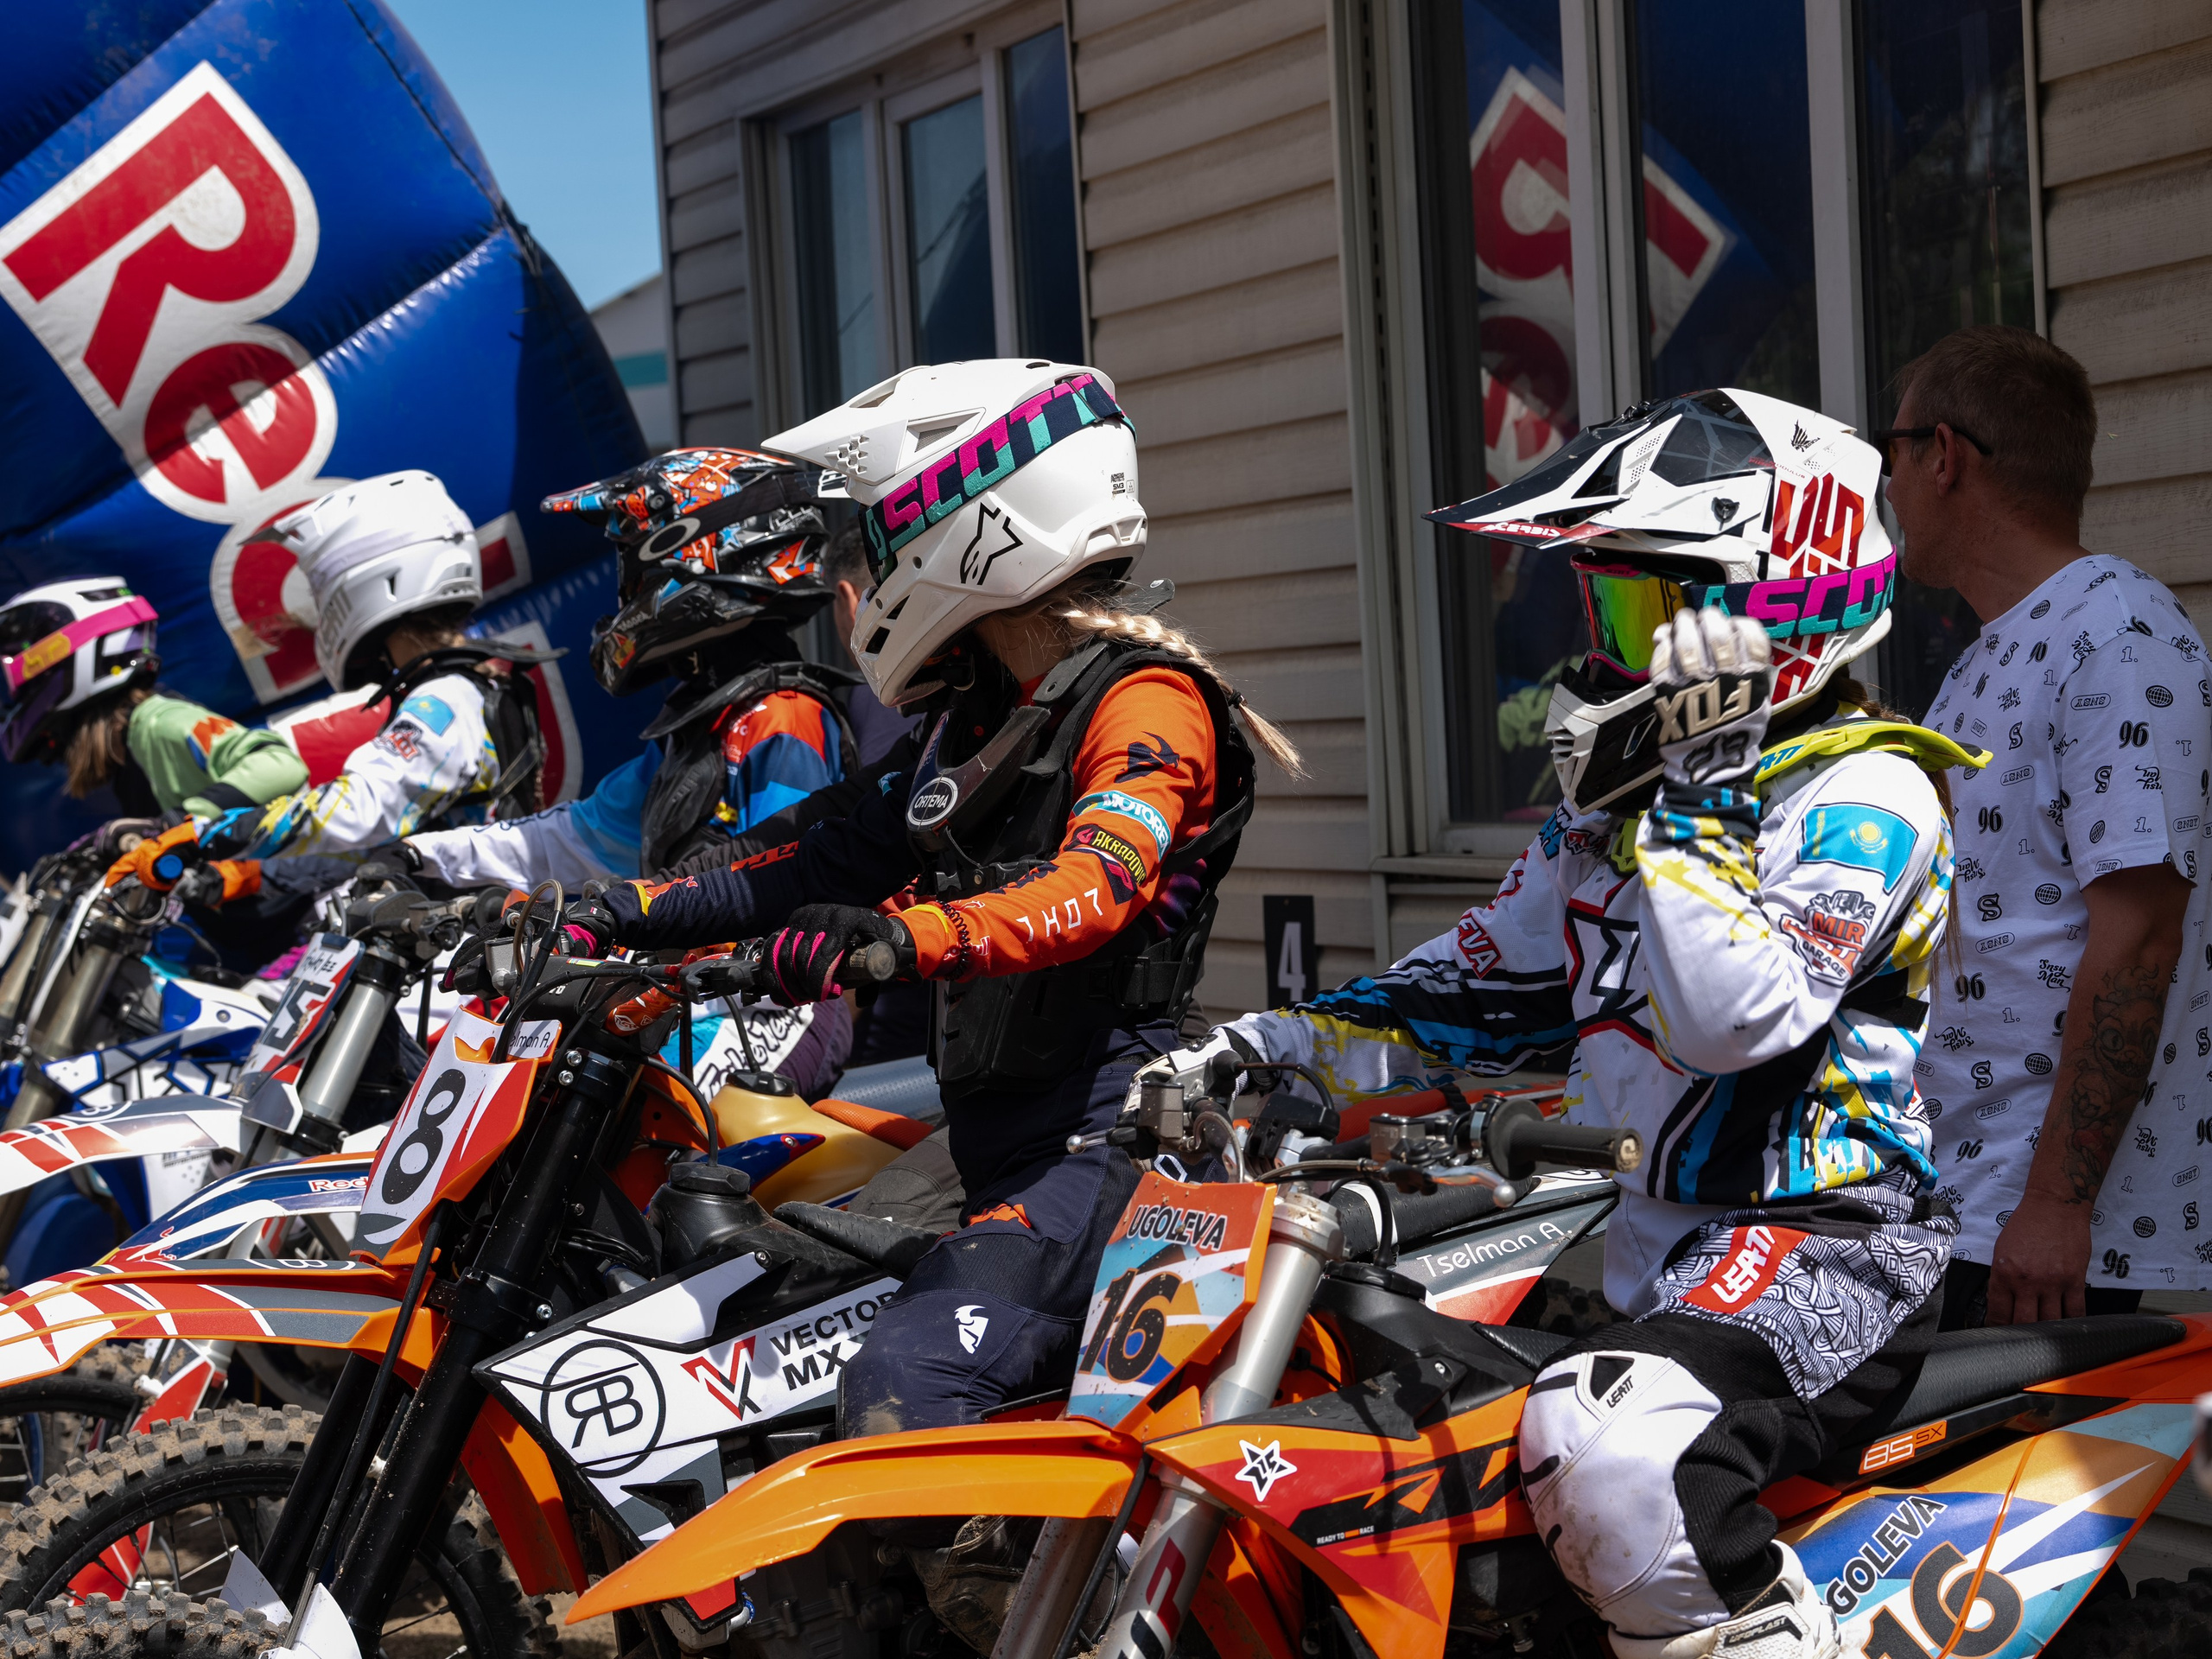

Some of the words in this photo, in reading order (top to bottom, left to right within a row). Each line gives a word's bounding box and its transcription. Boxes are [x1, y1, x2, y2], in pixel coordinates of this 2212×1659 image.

[2118, 720, 2150, 749] 96
[914, 793, 950, 809] ORTEMA
[1978, 804, 2004, 835] 96
[1977, 893, 2003, 922] S
[1814, 912, 1866, 944] MIR
[1278, 921, 1306, 1002] 4
[1802, 940, 1847, 977] GARAGE
[1954, 971, 1986, 1002] 96
[1970, 1059, 1993, 1090] S
[380, 1068, 467, 1205] 8
[1955, 1138, 1985, 1164] 96
[1127, 1205, 1228, 1251] UGOLEVA
[2183, 1201, 2200, 1231] S
[1416, 1234, 1538, 1278] Tselman
[2101, 1247, 2133, 1280] 96
[1077, 1267, 1184, 1383] 16
[782, 1342, 847, 1391] MX
[1606, 1375, 1635, 1409] LEATT
[1863, 1434, 1914, 1471] 85
[1915, 1424, 1944, 1445] SX
[1316, 1534, 1337, 1545] READY
[1359, 1525, 1375, 1535] RACE
